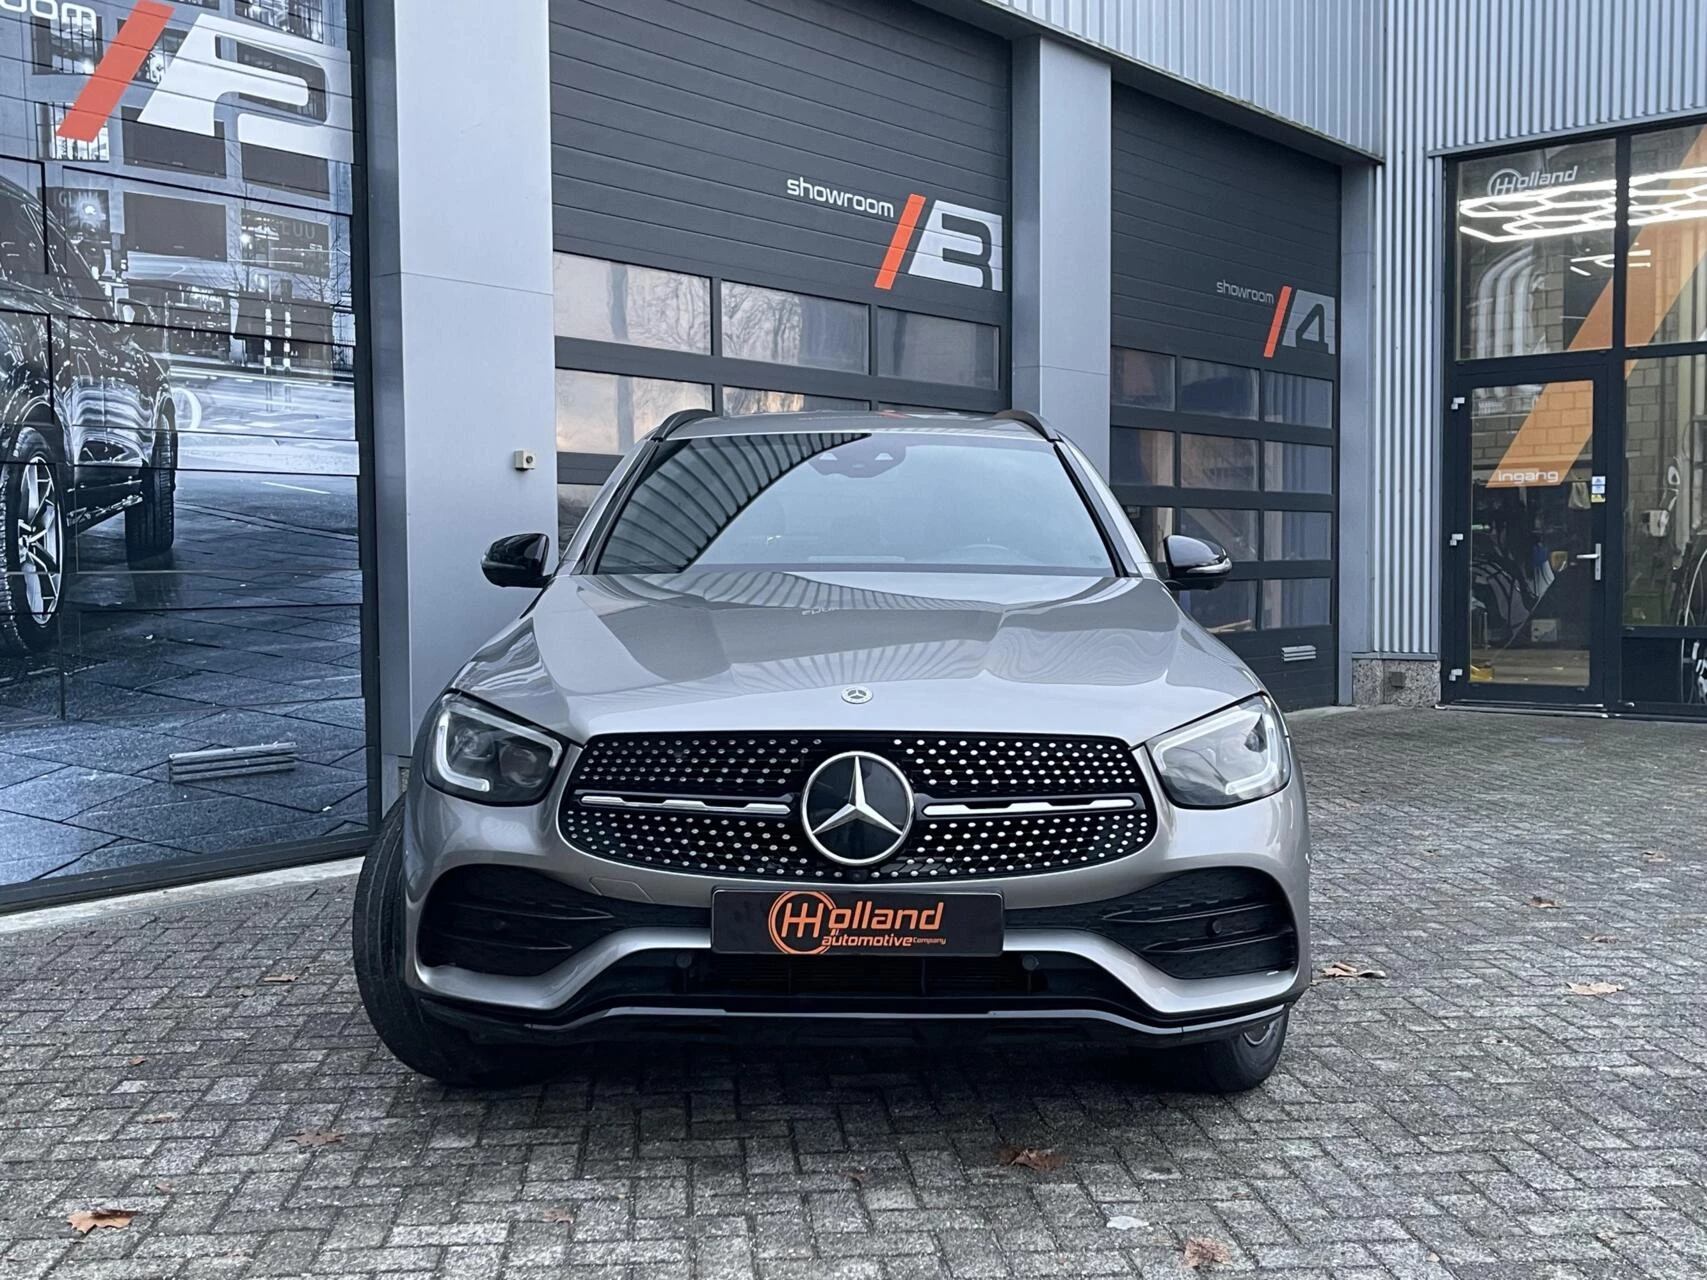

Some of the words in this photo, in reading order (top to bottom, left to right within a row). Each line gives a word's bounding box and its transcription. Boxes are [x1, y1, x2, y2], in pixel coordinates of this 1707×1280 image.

[787, 177, 894, 218] showroom
[1216, 280, 1275, 305] showroom
[1498, 470, 1559, 484] ingang
[822, 934, 913, 947] automotive
[913, 936, 947, 945] Company
